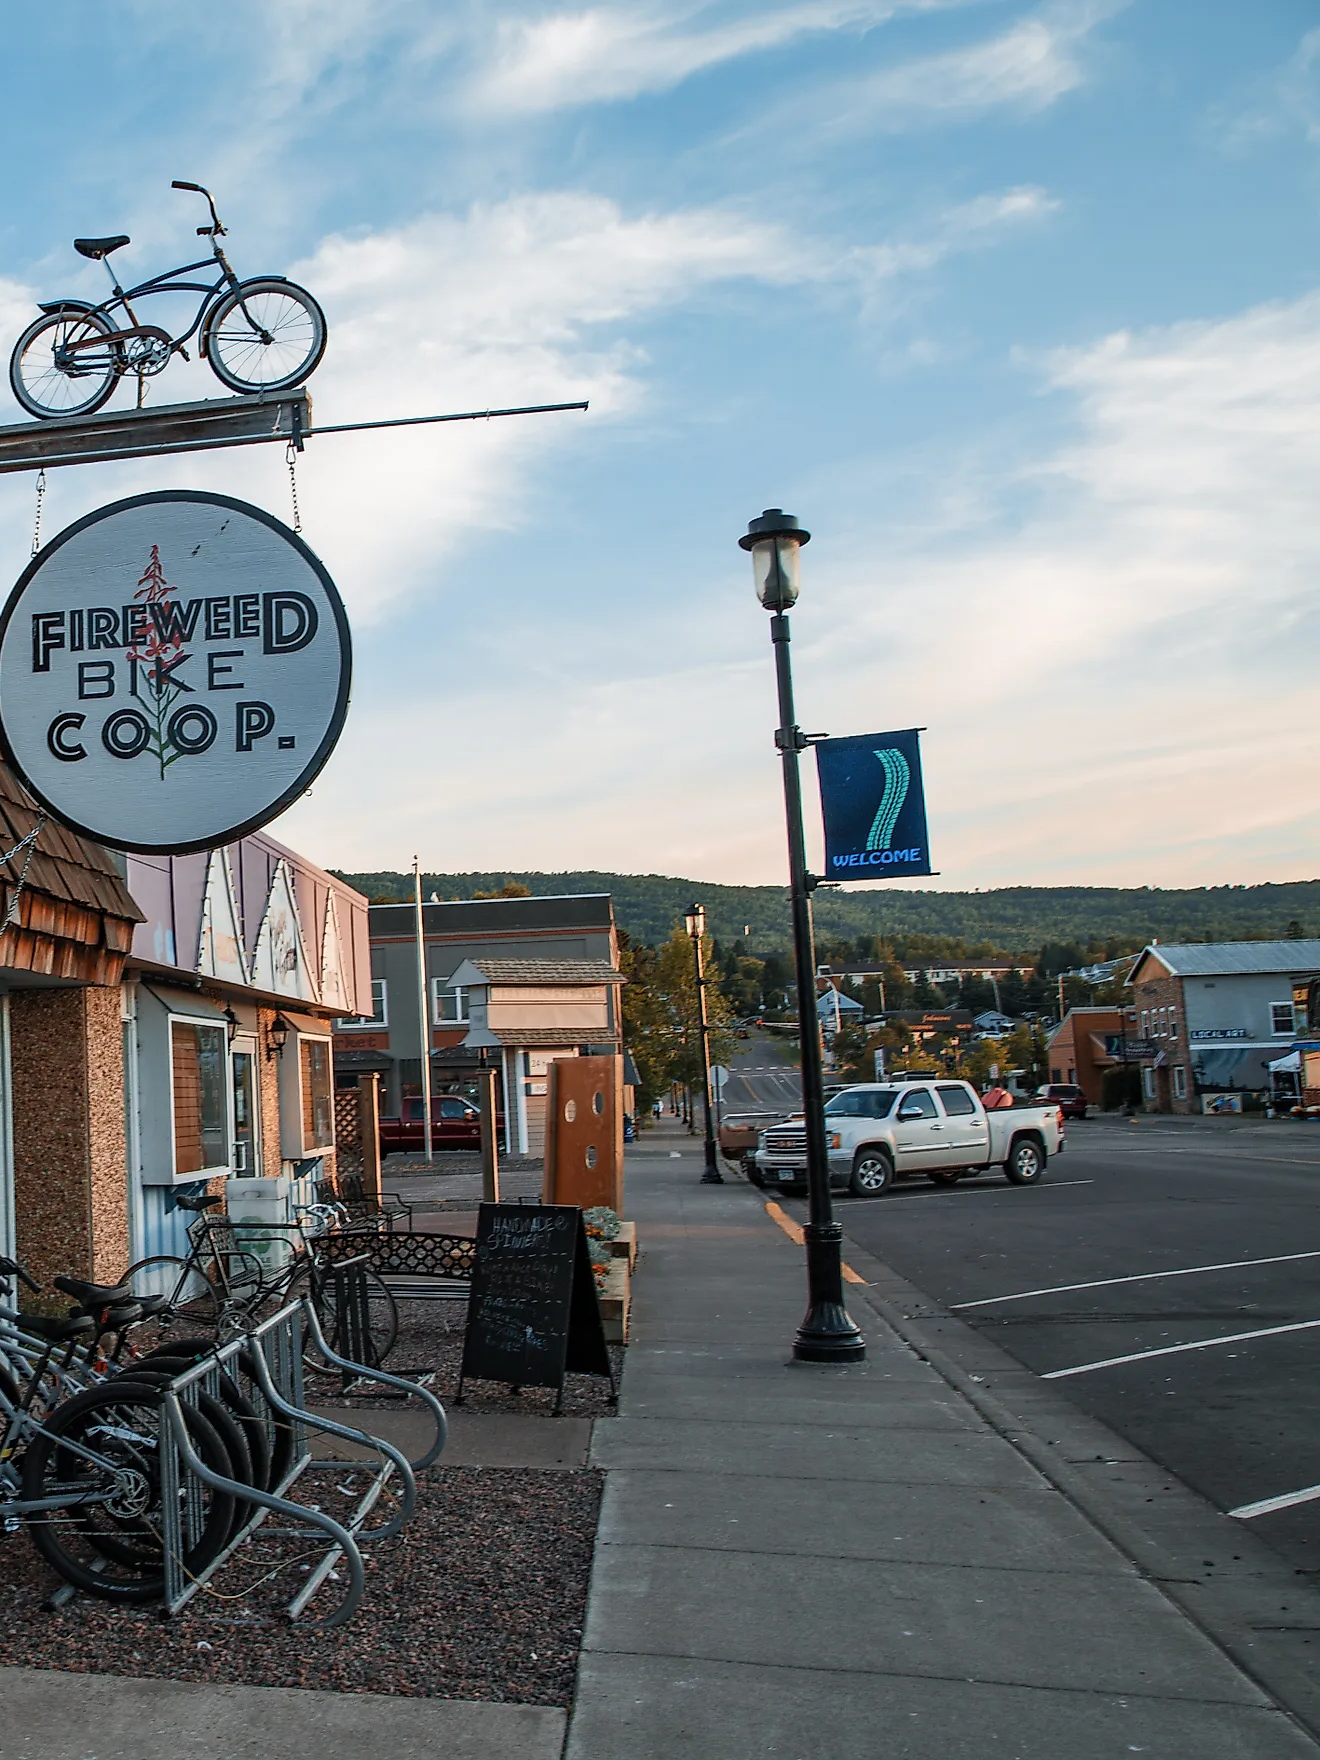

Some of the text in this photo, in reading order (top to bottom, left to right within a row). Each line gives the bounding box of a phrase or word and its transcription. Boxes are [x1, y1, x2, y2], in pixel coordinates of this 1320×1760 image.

[32, 591, 318, 672] FIREWEED
[78, 650, 244, 699] BIKE
[832, 848, 921, 867] WELCOME
